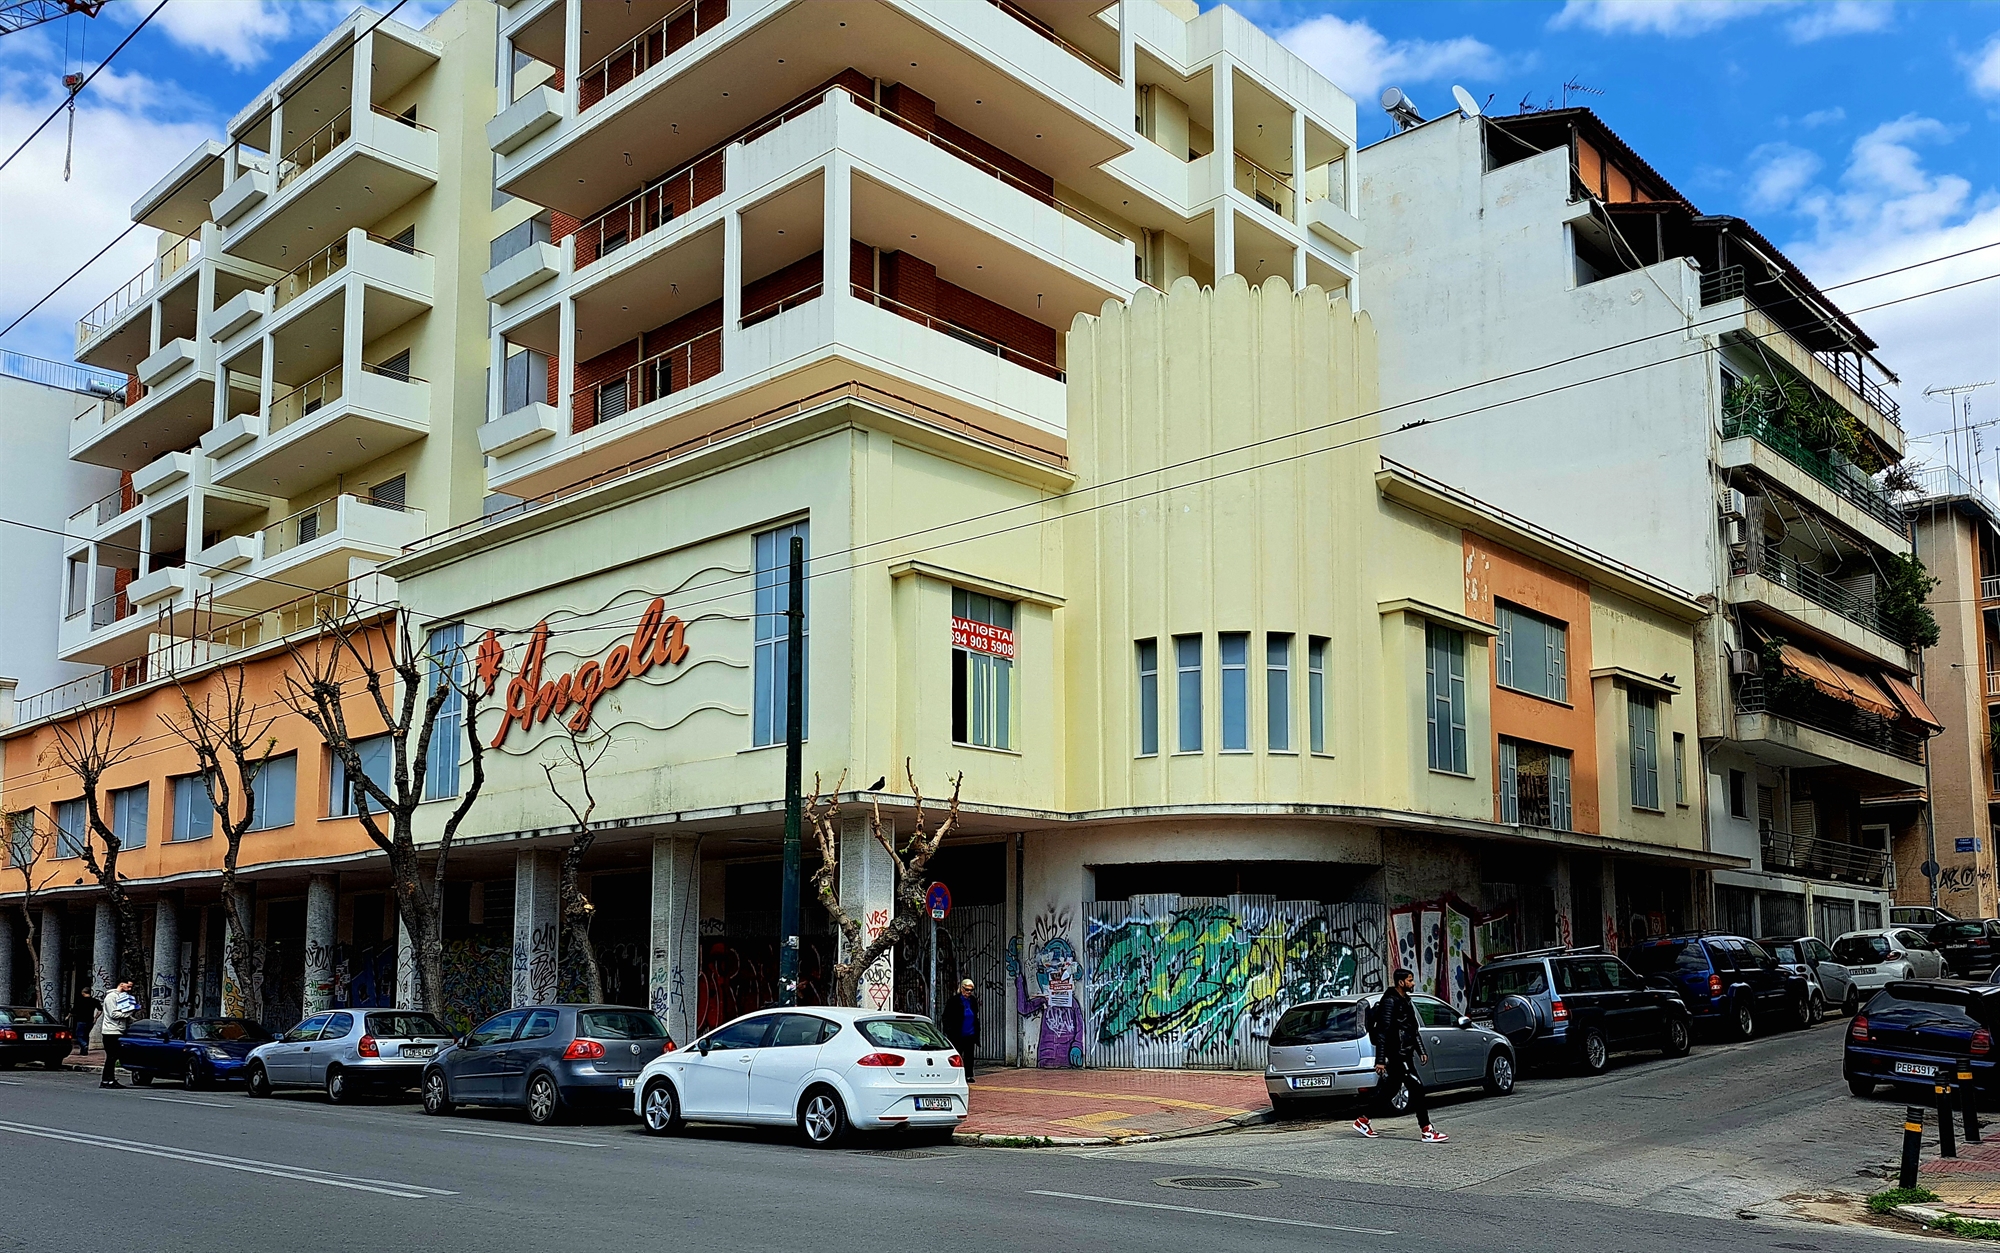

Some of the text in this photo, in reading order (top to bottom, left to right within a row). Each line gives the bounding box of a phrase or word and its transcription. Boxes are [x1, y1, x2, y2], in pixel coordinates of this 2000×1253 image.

[951, 618, 1013, 642] ΔΙΑΤΙΘΕΤΑΙ
[969, 635, 988, 650] 903
[991, 639, 1014, 656] 5908
[490, 597, 690, 748] Angela
